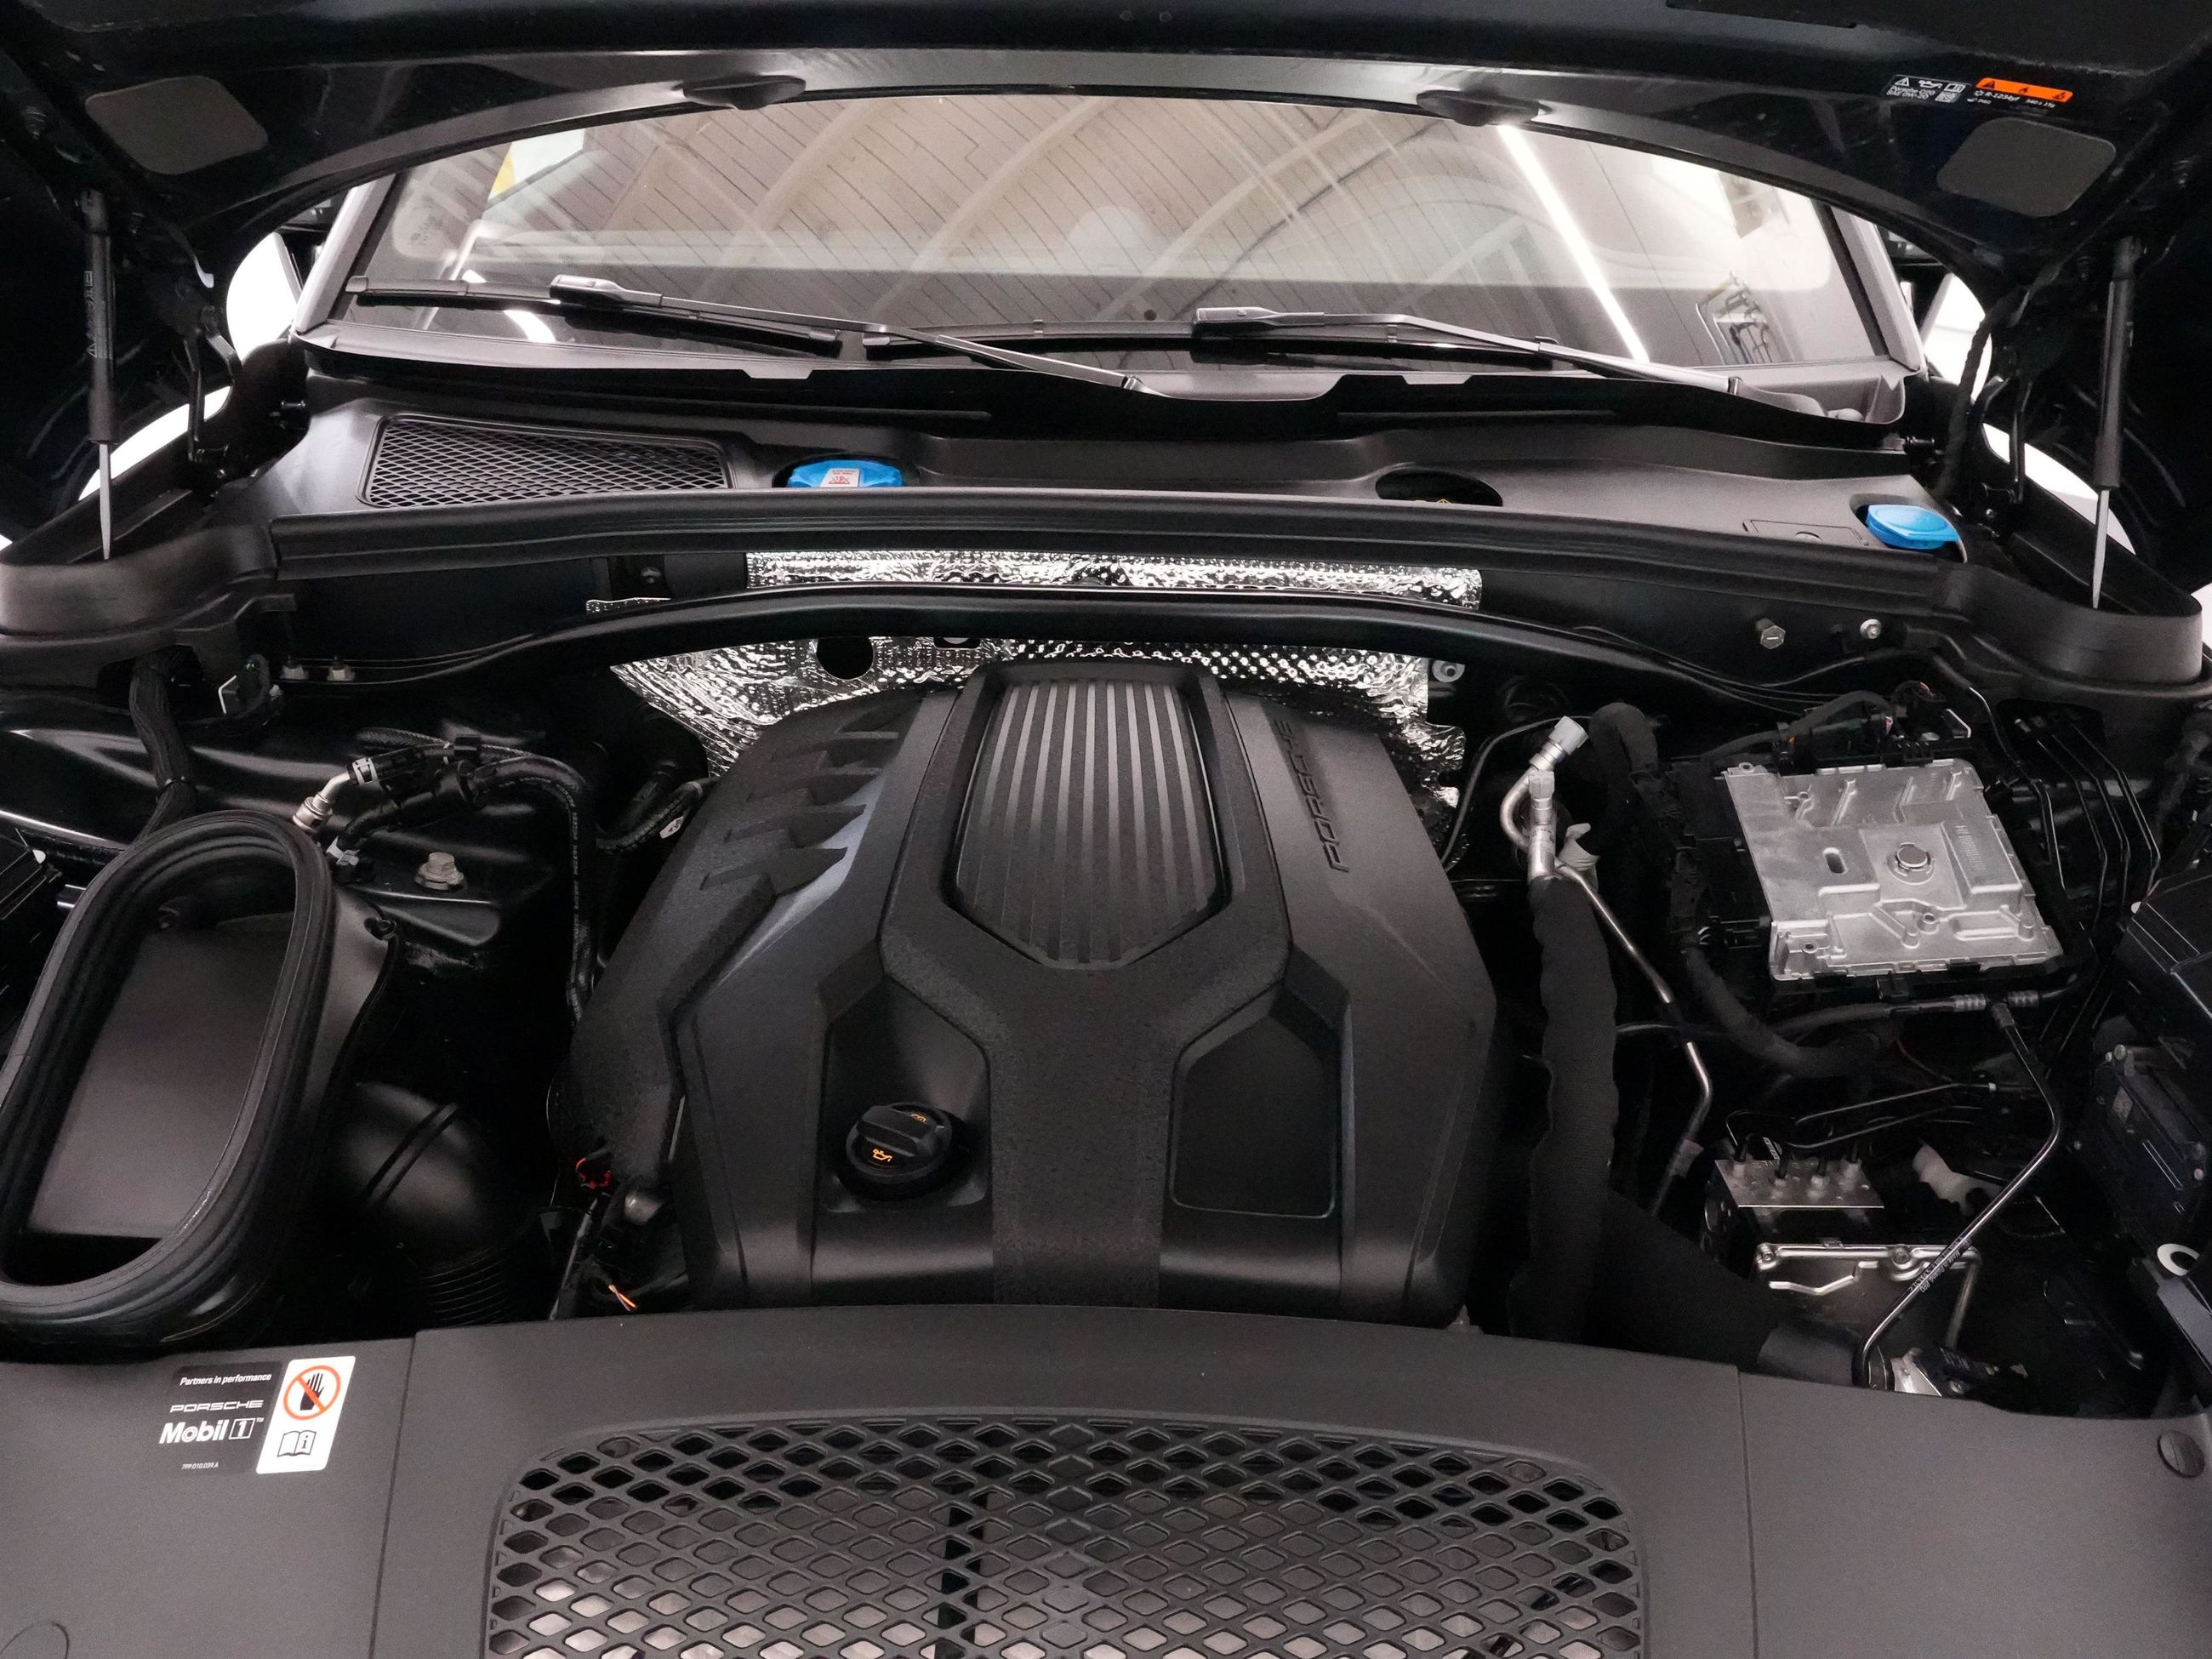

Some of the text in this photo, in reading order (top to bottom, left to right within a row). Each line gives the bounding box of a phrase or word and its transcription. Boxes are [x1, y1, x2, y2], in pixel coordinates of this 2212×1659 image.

[1274, 720, 1349, 873] PORSCHE
[180, 1373, 272, 1386] Partners in performance
[170, 1400, 264, 1413] PORSCHE
[159, 1419, 230, 1444] Mobil
